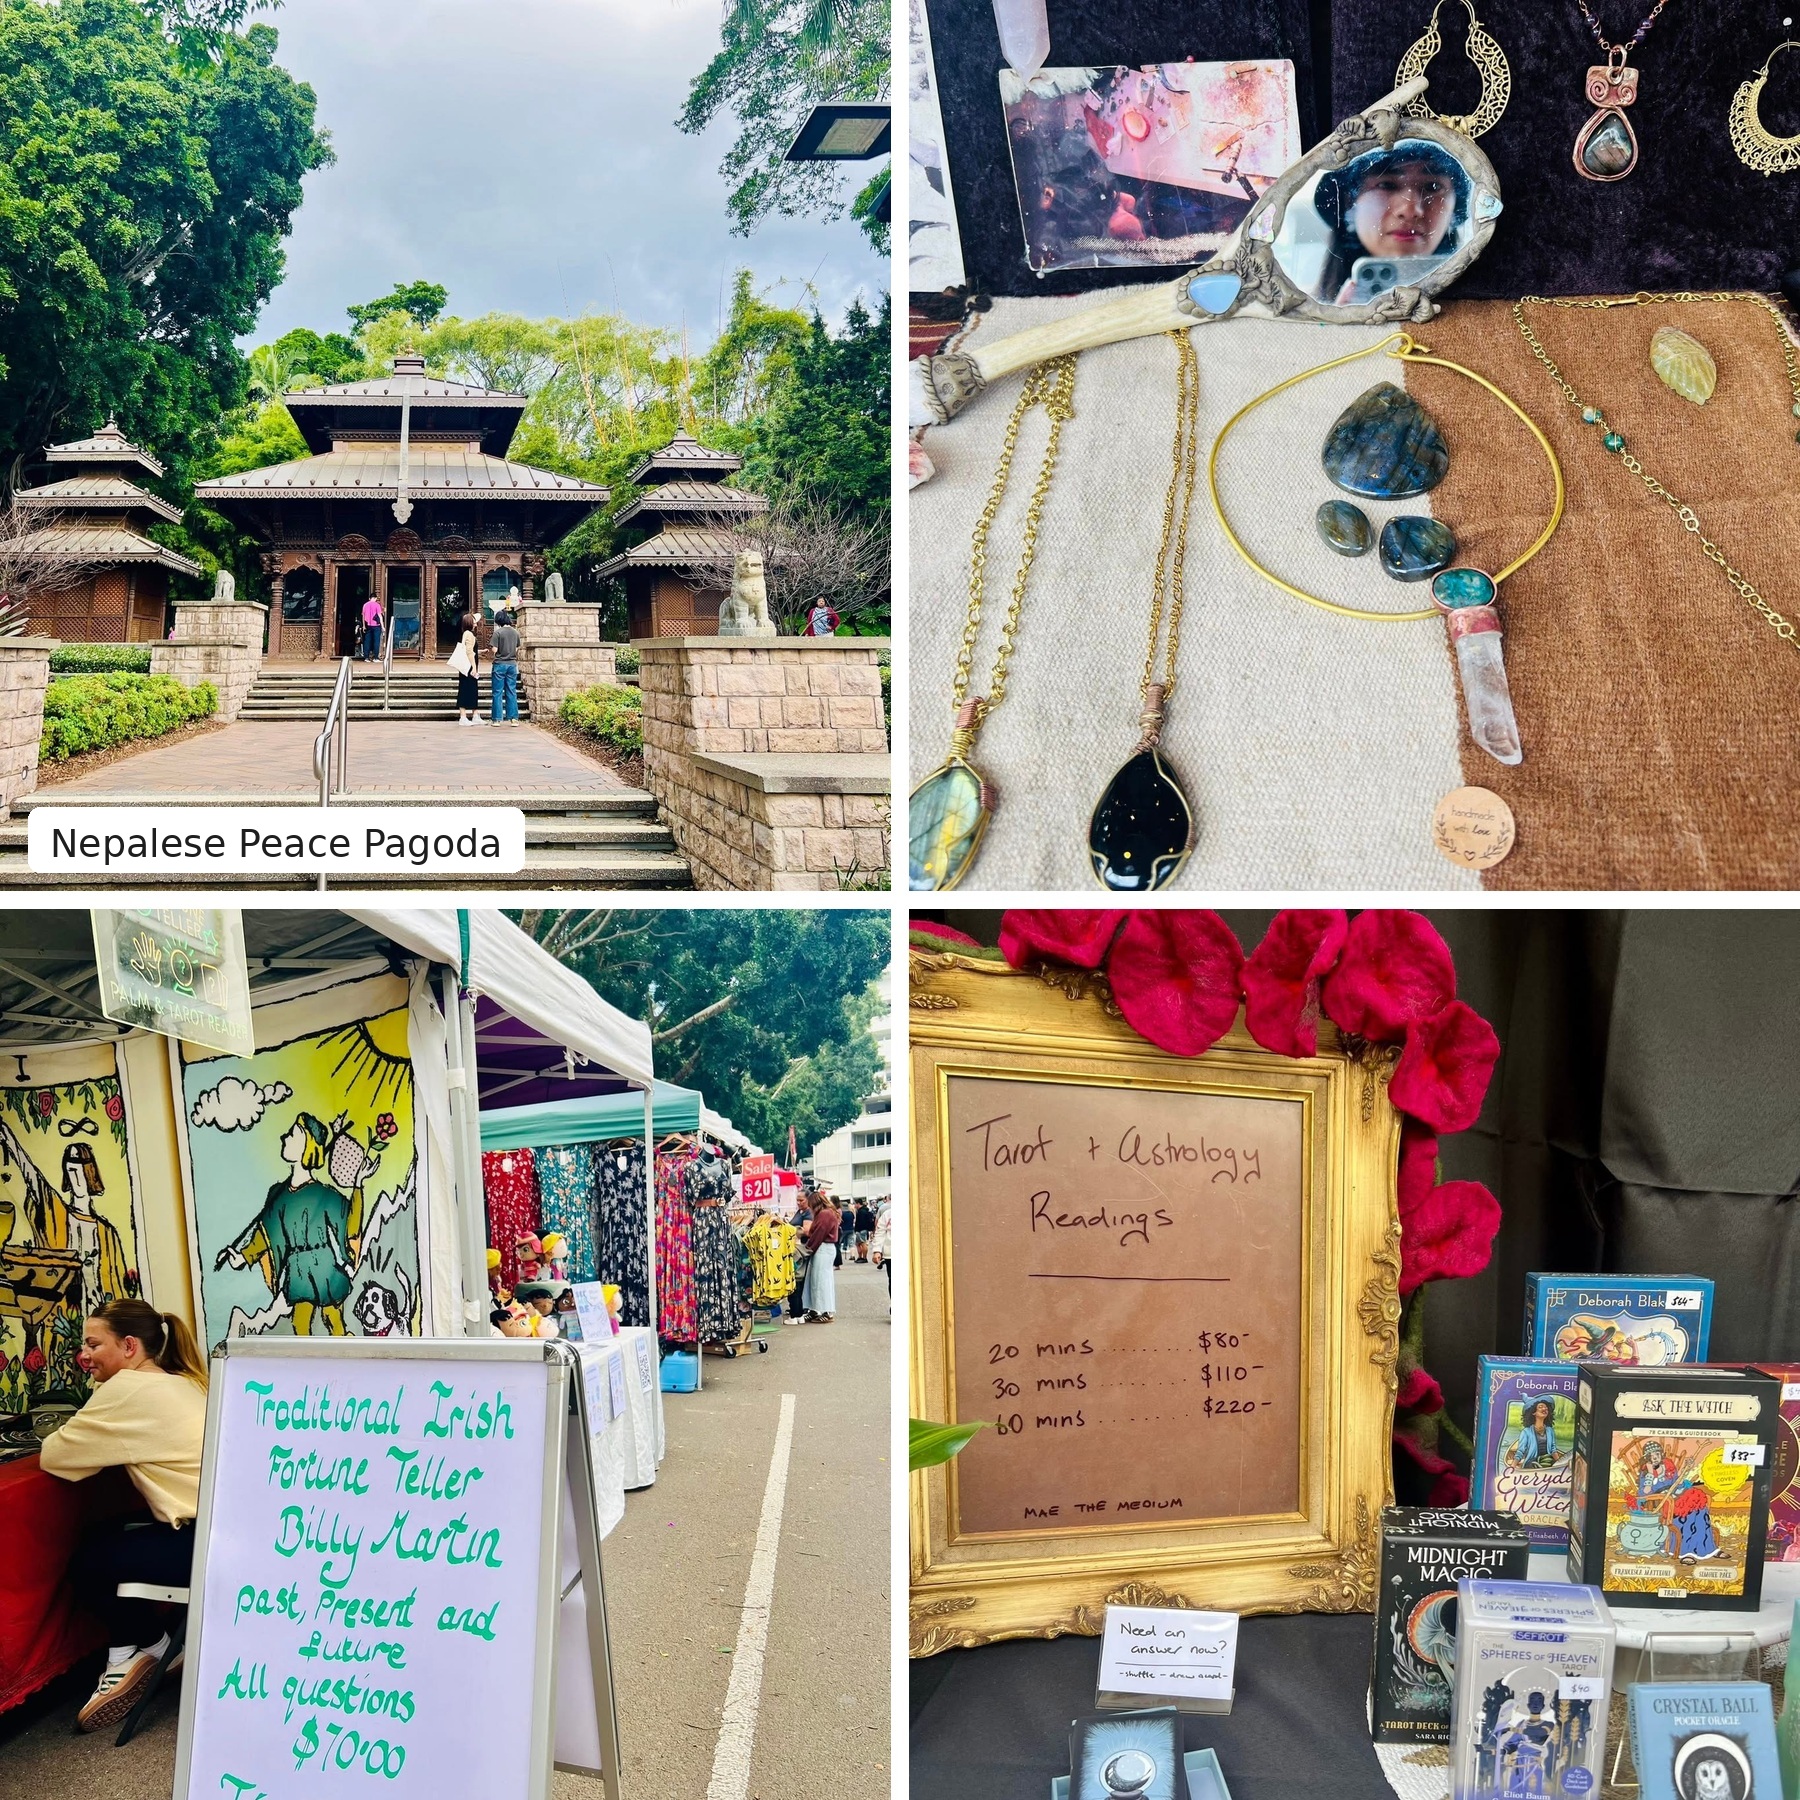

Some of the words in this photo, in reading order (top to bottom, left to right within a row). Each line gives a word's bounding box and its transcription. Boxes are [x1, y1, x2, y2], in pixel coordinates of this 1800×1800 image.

[1451, 805, 1495, 821] handmade
[110, 980, 151, 1012] PALM
[155, 998, 165, 1015] &
[167, 1000, 205, 1028] TAROT
[208, 1014, 249, 1041] READER
[965, 1113, 1054, 1172] Tarot
[1088, 1135, 1100, 1160] +
[1117, 1124, 1262, 1184] Astrology
[744, 1160, 771, 1177] Sale
[1029, 1190, 1175, 1247] Readings
[1579, 1294, 1632, 1307] Deborah
[988, 1343, 1020, 1365] 20
[1036, 1338, 1095, 1357] mins
[992, 1378, 1020, 1399] 30
[1036, 1372, 1088, 1391] mins
[1516, 1379, 1559, 1391] Deborah
[244, 1379, 405, 1436] Traditional
[423, 1379, 515, 1440] Irish
[1642, 1399, 1667, 1415] ASK
[1670, 1400, 1693, 1413] THE
[1696, 1401, 1733, 1414] WITCH
[996, 1412, 1024, 1436] 60
[1036, 1409, 1086, 1428] mins
[267, 1443, 371, 1496] Fortune
[385, 1445, 485, 1501] Teller
[1024, 1505, 1060, 1519] MAE
[1074, 1500, 1107, 1513] THE
[1116, 1497, 1183, 1511] MEDIUM
[1408, 1519, 1500, 1529] MIDNIGHT
[1523, 1515, 1560, 1525] ORACLE
[1528, 1531, 1559, 1540] Elisabeth
[273, 1504, 366, 1590] Billy
[370, 1509, 503, 1569] Martin
[1407, 1546, 1508, 1566] MIDNIGHT
[1420, 1565, 1492, 1583] MAGIC
[436, 1600, 501, 1642] and
[1120, 1622, 1157, 1638] Need
[1165, 1629, 1186, 1639] an
[1516, 1631, 1562, 1641] SEFIROT
[298, 1630, 408, 1671] future
[1131, 1645, 1183, 1656] answer
[1190, 1640, 1228, 1659] now?
[1480, 1649, 1532, 1660] SPHERES
[1547, 1652, 1598, 1664] HEAVEN
[1169, 1671, 1195, 1679] draw
[217, 1656, 270, 1701] All
[281, 1672, 417, 1725] questions
[1653, 1697, 1719, 1715] CRYSTAL
[1722, 1697, 1759, 1714] BALL
[1385, 1721, 1415, 1729] TAROT
[1416, 1722, 1439, 1730] DECK
[1674, 1716, 1707, 1726] POCKET
[1708, 1716, 1740, 1726] ORACLE
[1503, 1790, 1523, 1799] Eliot
